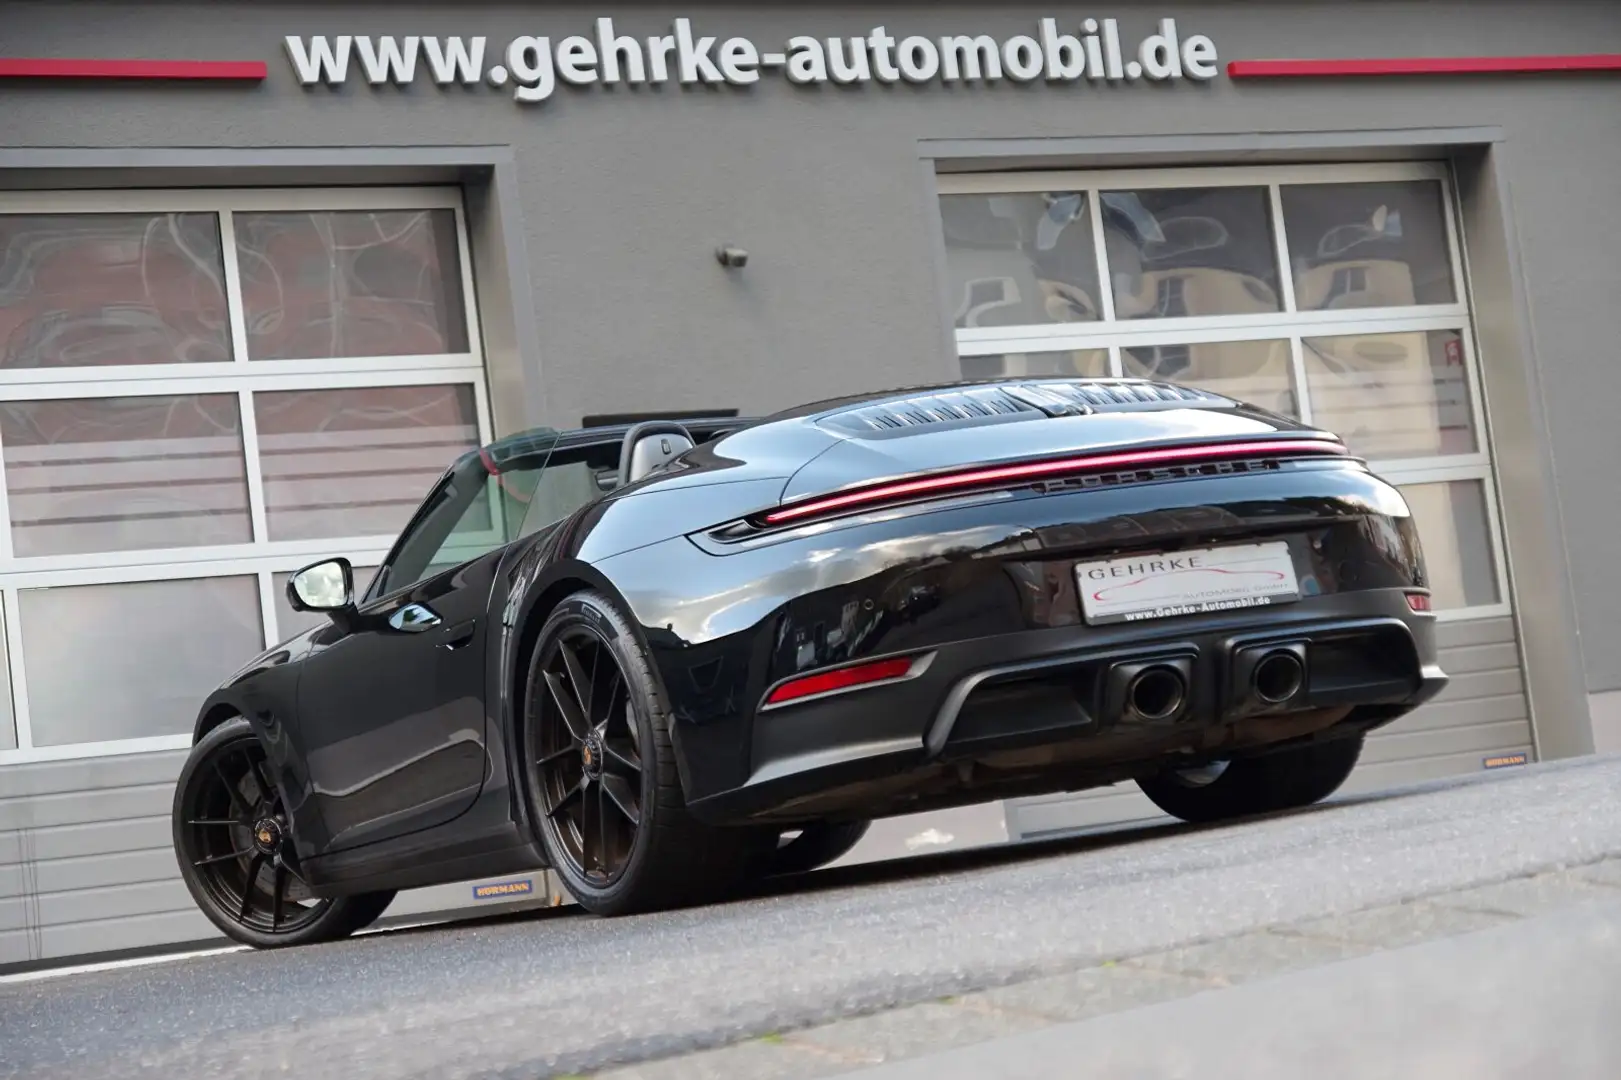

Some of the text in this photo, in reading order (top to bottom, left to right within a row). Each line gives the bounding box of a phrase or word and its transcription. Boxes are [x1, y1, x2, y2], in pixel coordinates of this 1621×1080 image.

[284, 17, 1219, 101] www.gehrke-automobil.de
[1088, 556, 1202, 580] GEHRKE
[1125, 596, 1271, 621] www.Gehrke-Automobil.de
